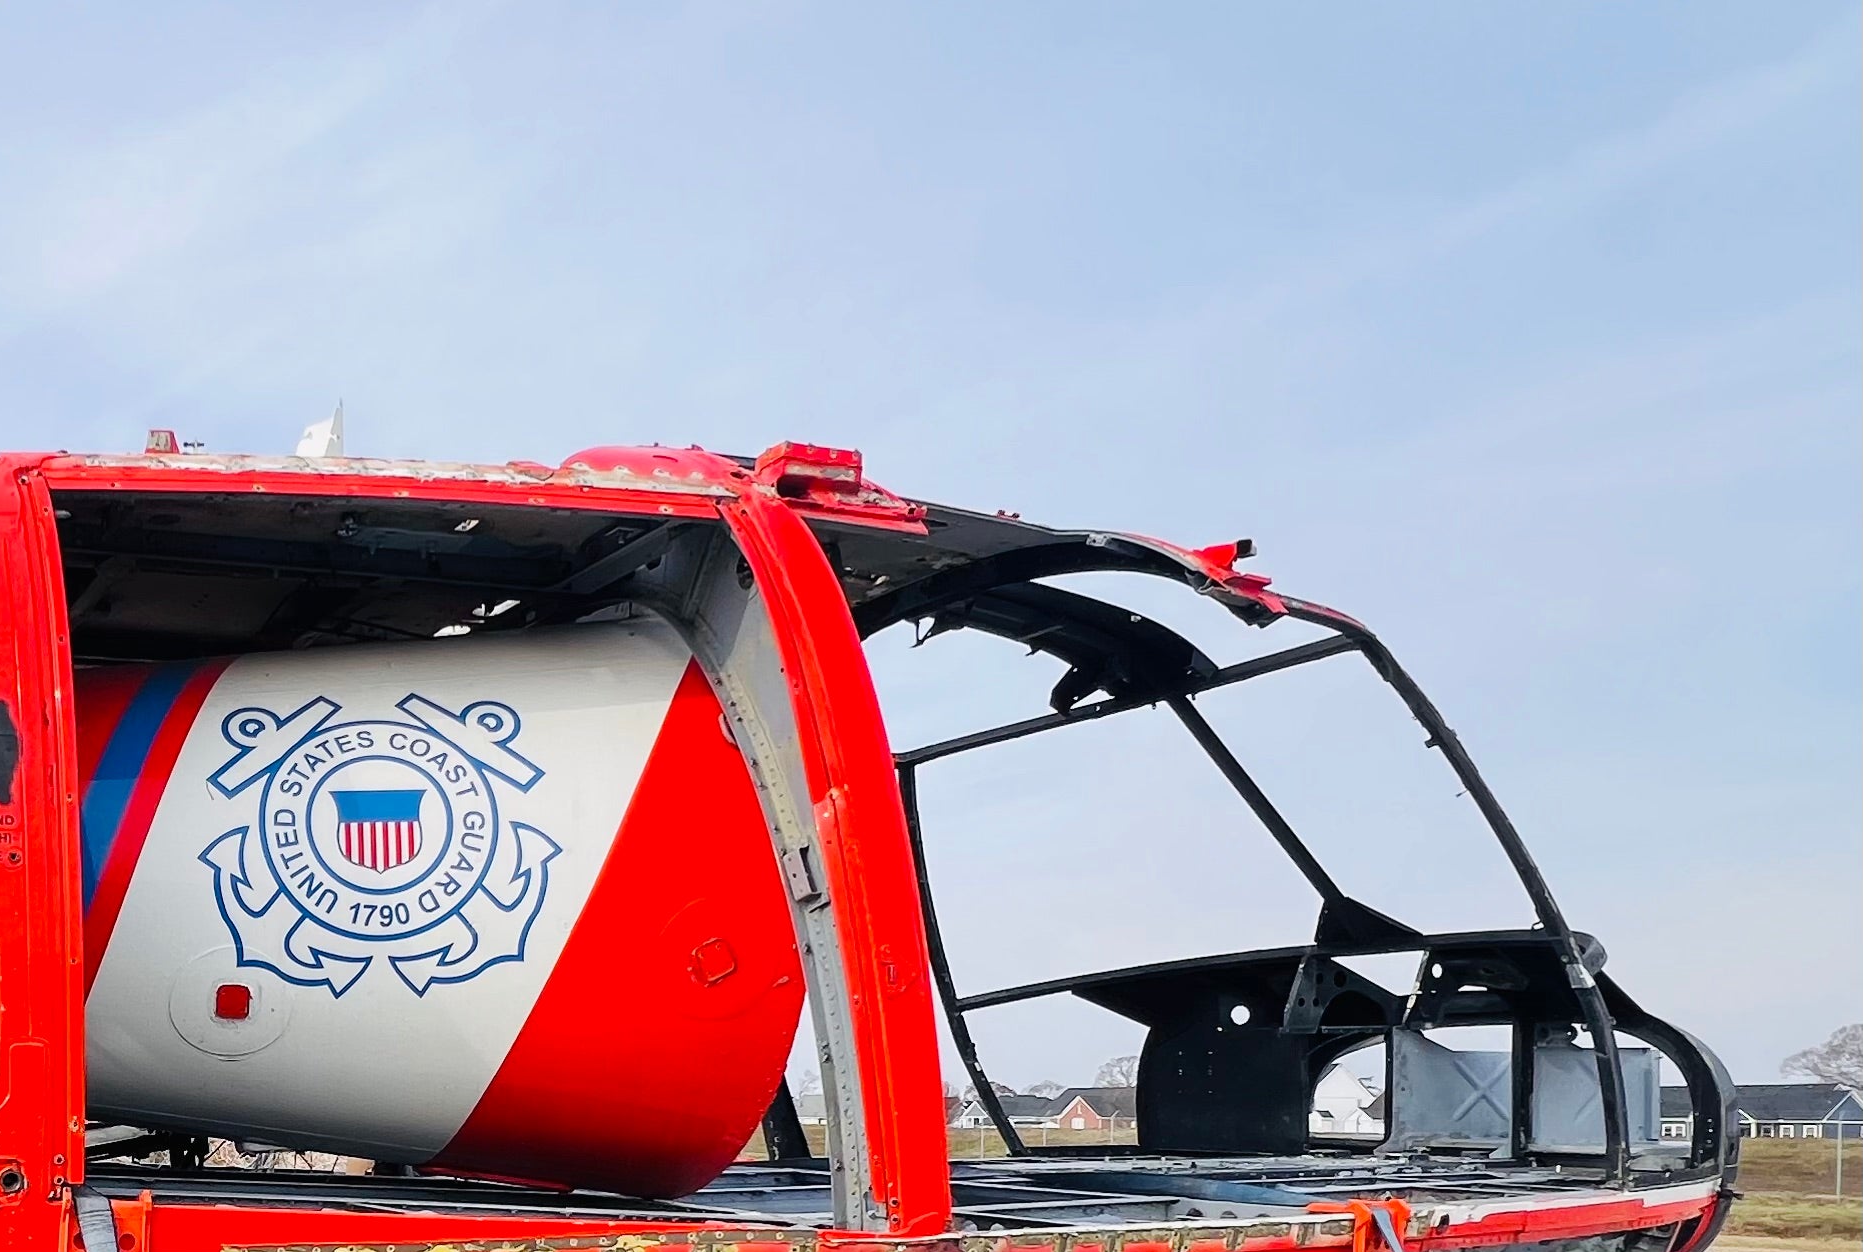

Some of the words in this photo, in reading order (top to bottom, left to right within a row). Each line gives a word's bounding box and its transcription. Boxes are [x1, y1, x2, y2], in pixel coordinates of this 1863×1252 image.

[279, 730, 375, 797] STATES
[388, 732, 480, 798] COAST
[273, 808, 339, 914] UNITED
[418, 810, 486, 914] GUARD
[348, 901, 411, 928] 1790
